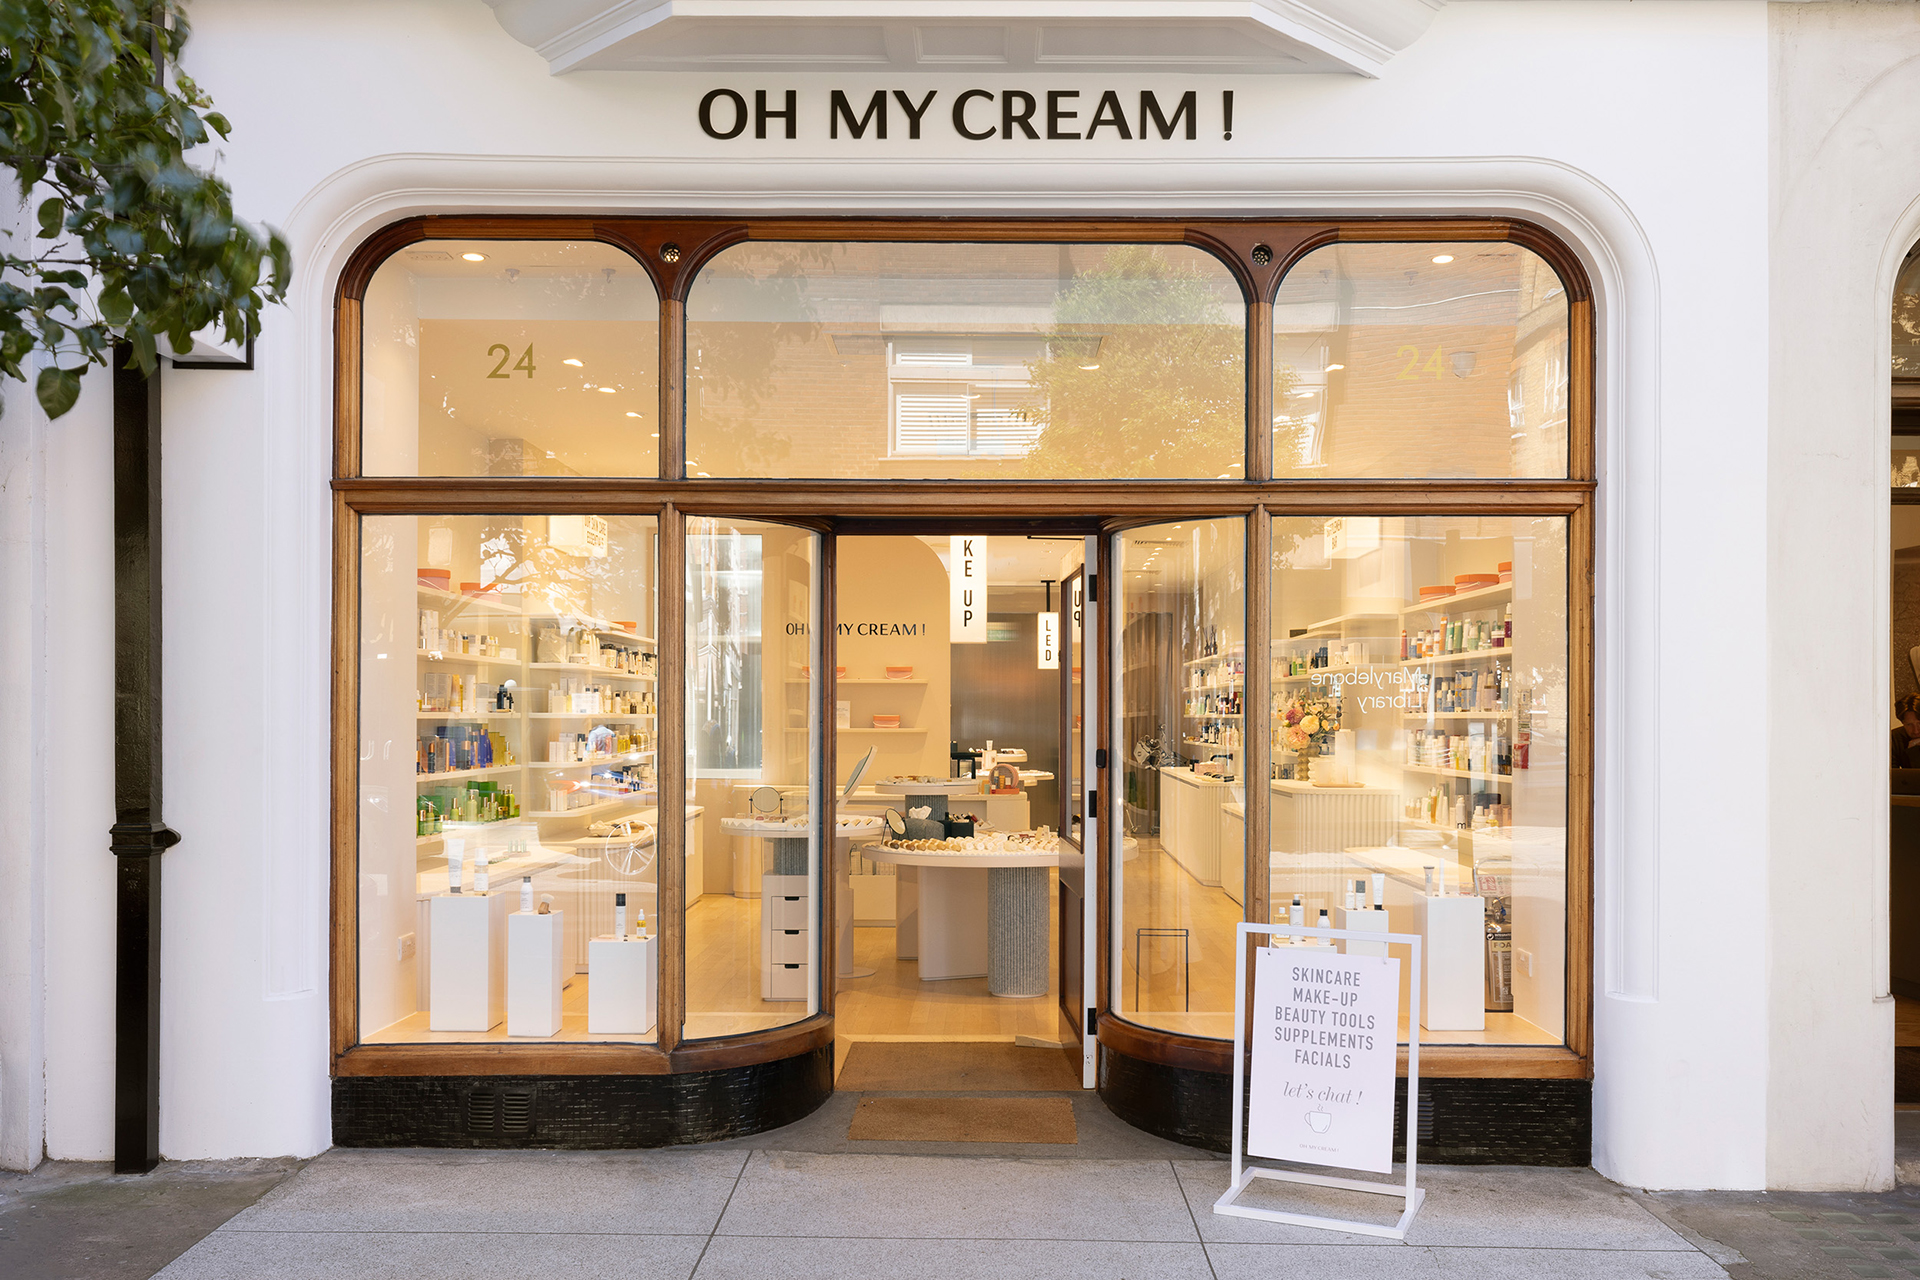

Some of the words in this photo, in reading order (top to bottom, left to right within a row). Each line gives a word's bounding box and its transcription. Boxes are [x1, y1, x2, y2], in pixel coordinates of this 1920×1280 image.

[699, 88, 797, 141] OH
[830, 90, 937, 140] MY
[952, 88, 1197, 141] CREAM
[1223, 90, 1235, 141] !
[486, 342, 536, 379] 24
[1396, 344, 1445, 380] 24
[963, 589, 973, 627] UP
[785, 622, 805, 635] OH
[857, 622, 917, 636] CREAM
[1292, 966, 1361, 987] SKINCARE
[1293, 987, 1358, 1007] MAKE-UP
[1275, 1006, 1326, 1025] BEAUTY
[1331, 1011, 1375, 1030] TOOLS
[1274, 1026, 1374, 1050] SUPPLEMENTS
[1295, 1049, 1351, 1069] FACIALS
[1317, 1086, 1352, 1104] chat
